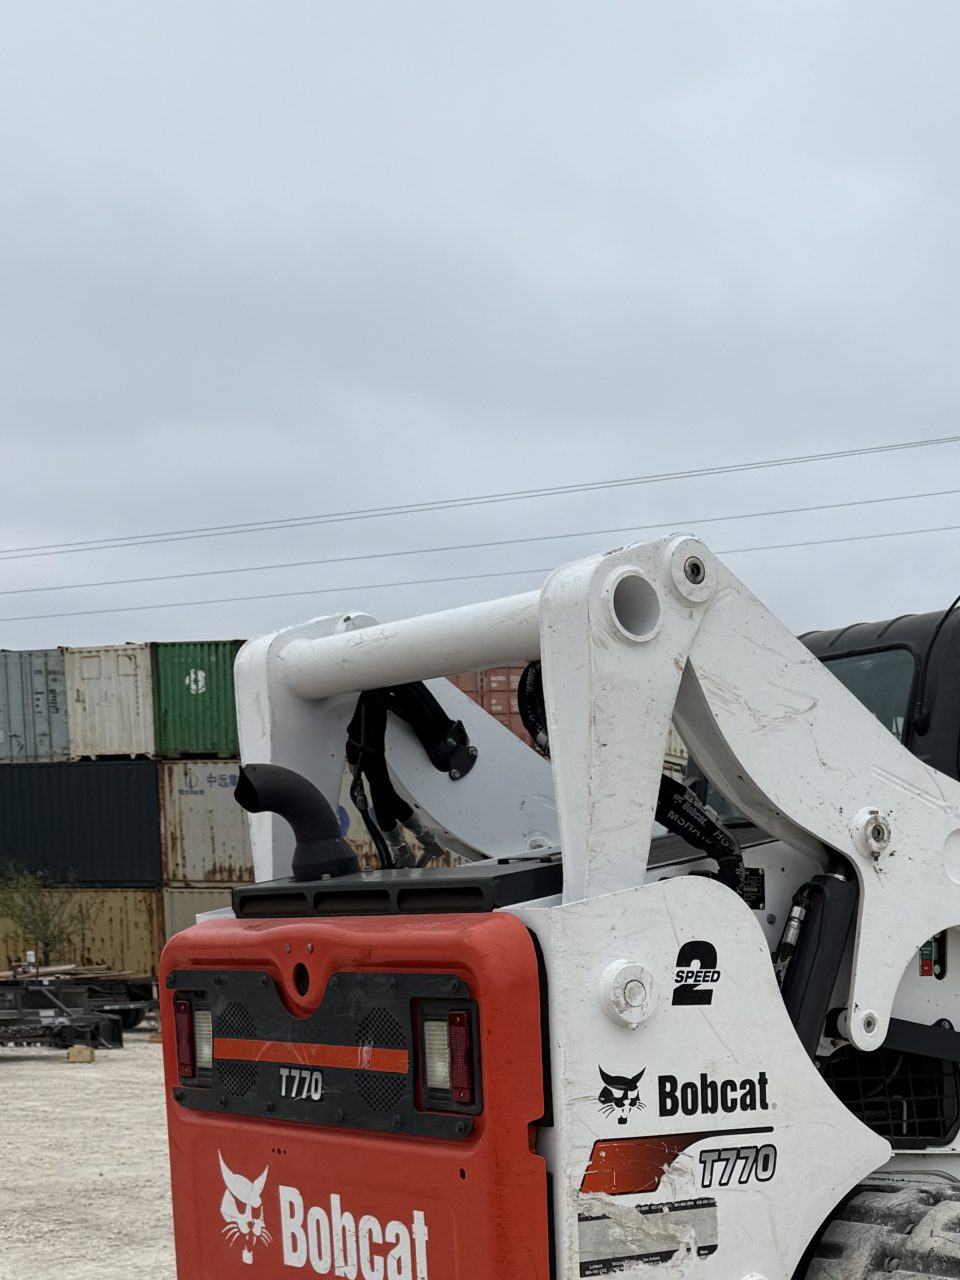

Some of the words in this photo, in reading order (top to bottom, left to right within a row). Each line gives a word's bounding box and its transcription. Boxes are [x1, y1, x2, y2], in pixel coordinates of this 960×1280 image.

[672, 940, 718, 1006] 2
[674, 969, 721, 985] SPEED
[280, 1068, 322, 1101] T770
[658, 1072, 769, 1117] Bobcat
[700, 1144, 777, 1188] T770
